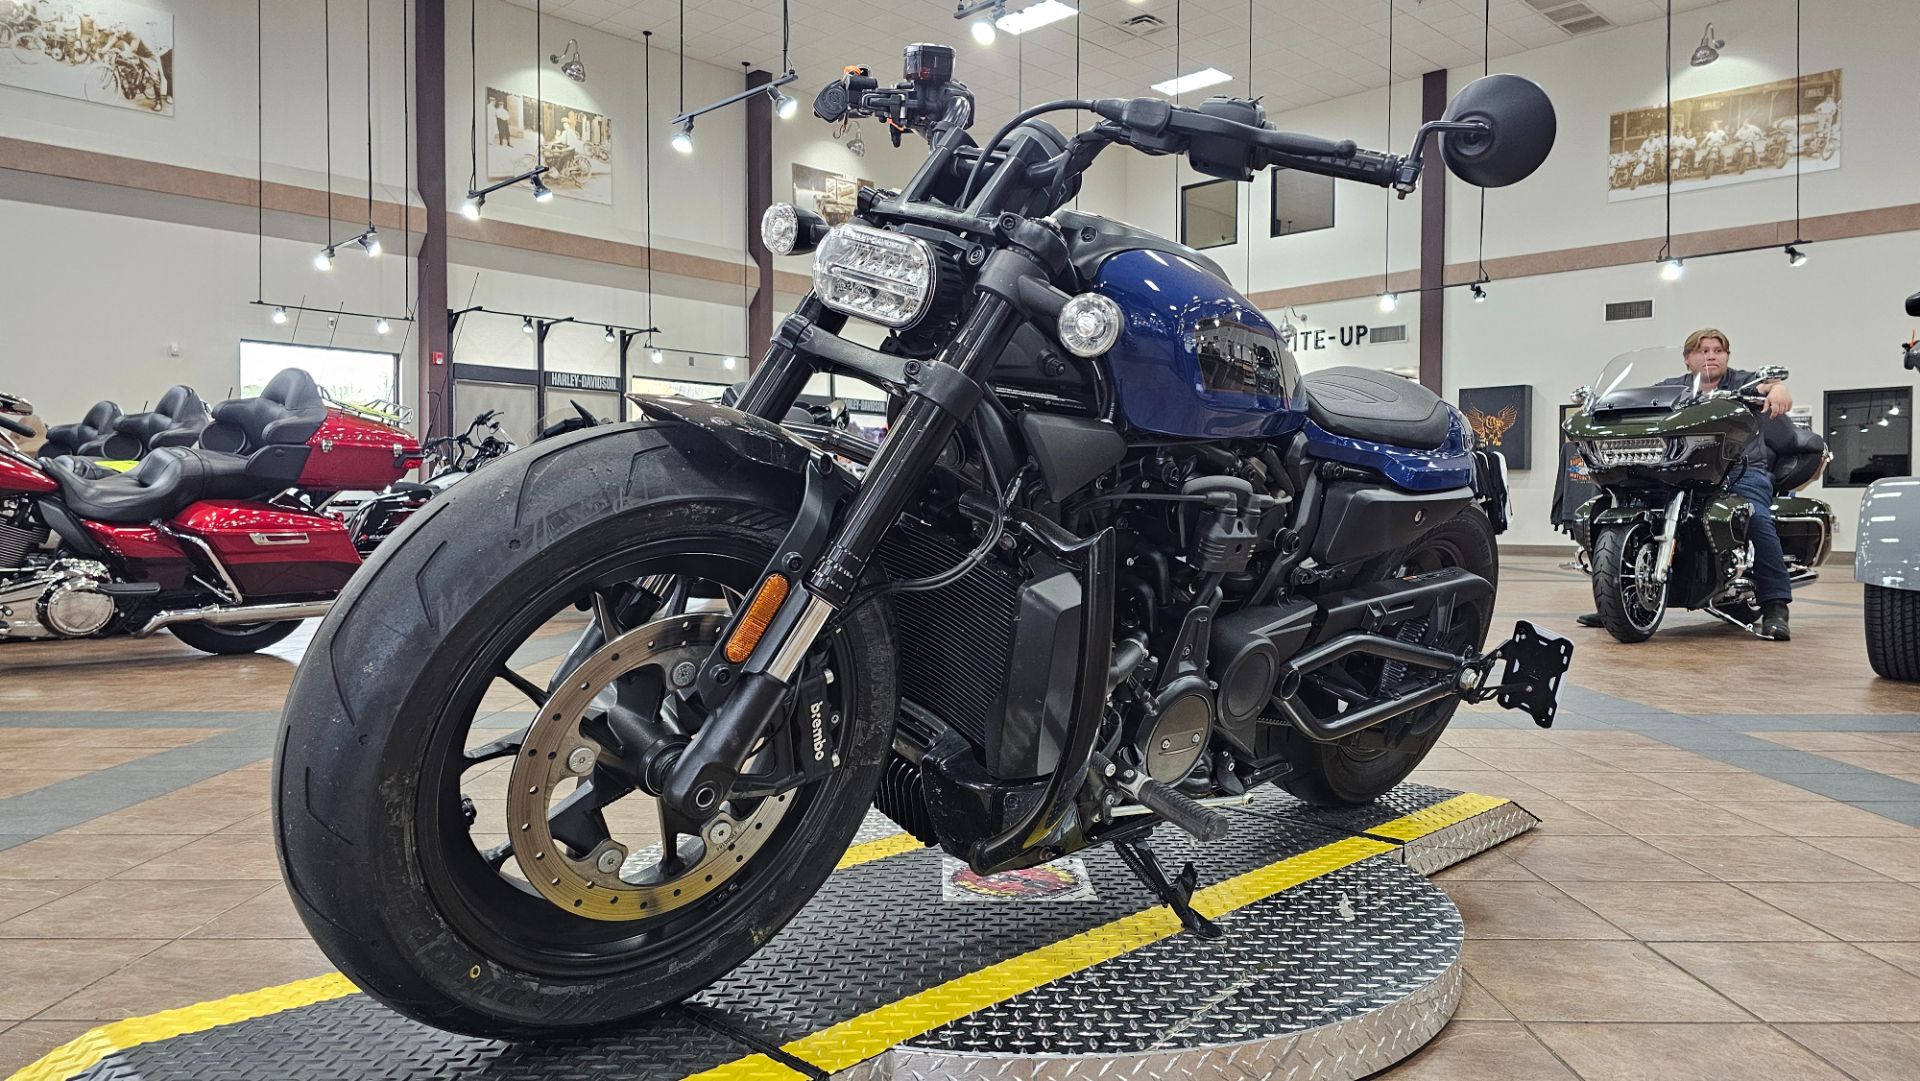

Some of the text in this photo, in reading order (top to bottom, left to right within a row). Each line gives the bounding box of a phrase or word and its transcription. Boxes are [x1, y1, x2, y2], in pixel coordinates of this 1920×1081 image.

[1290, 324, 1369, 352] ITE-UP
[551, 372, 617, 390] HARLEY-DAVIDSON
[810, 700, 827, 761] brembo
